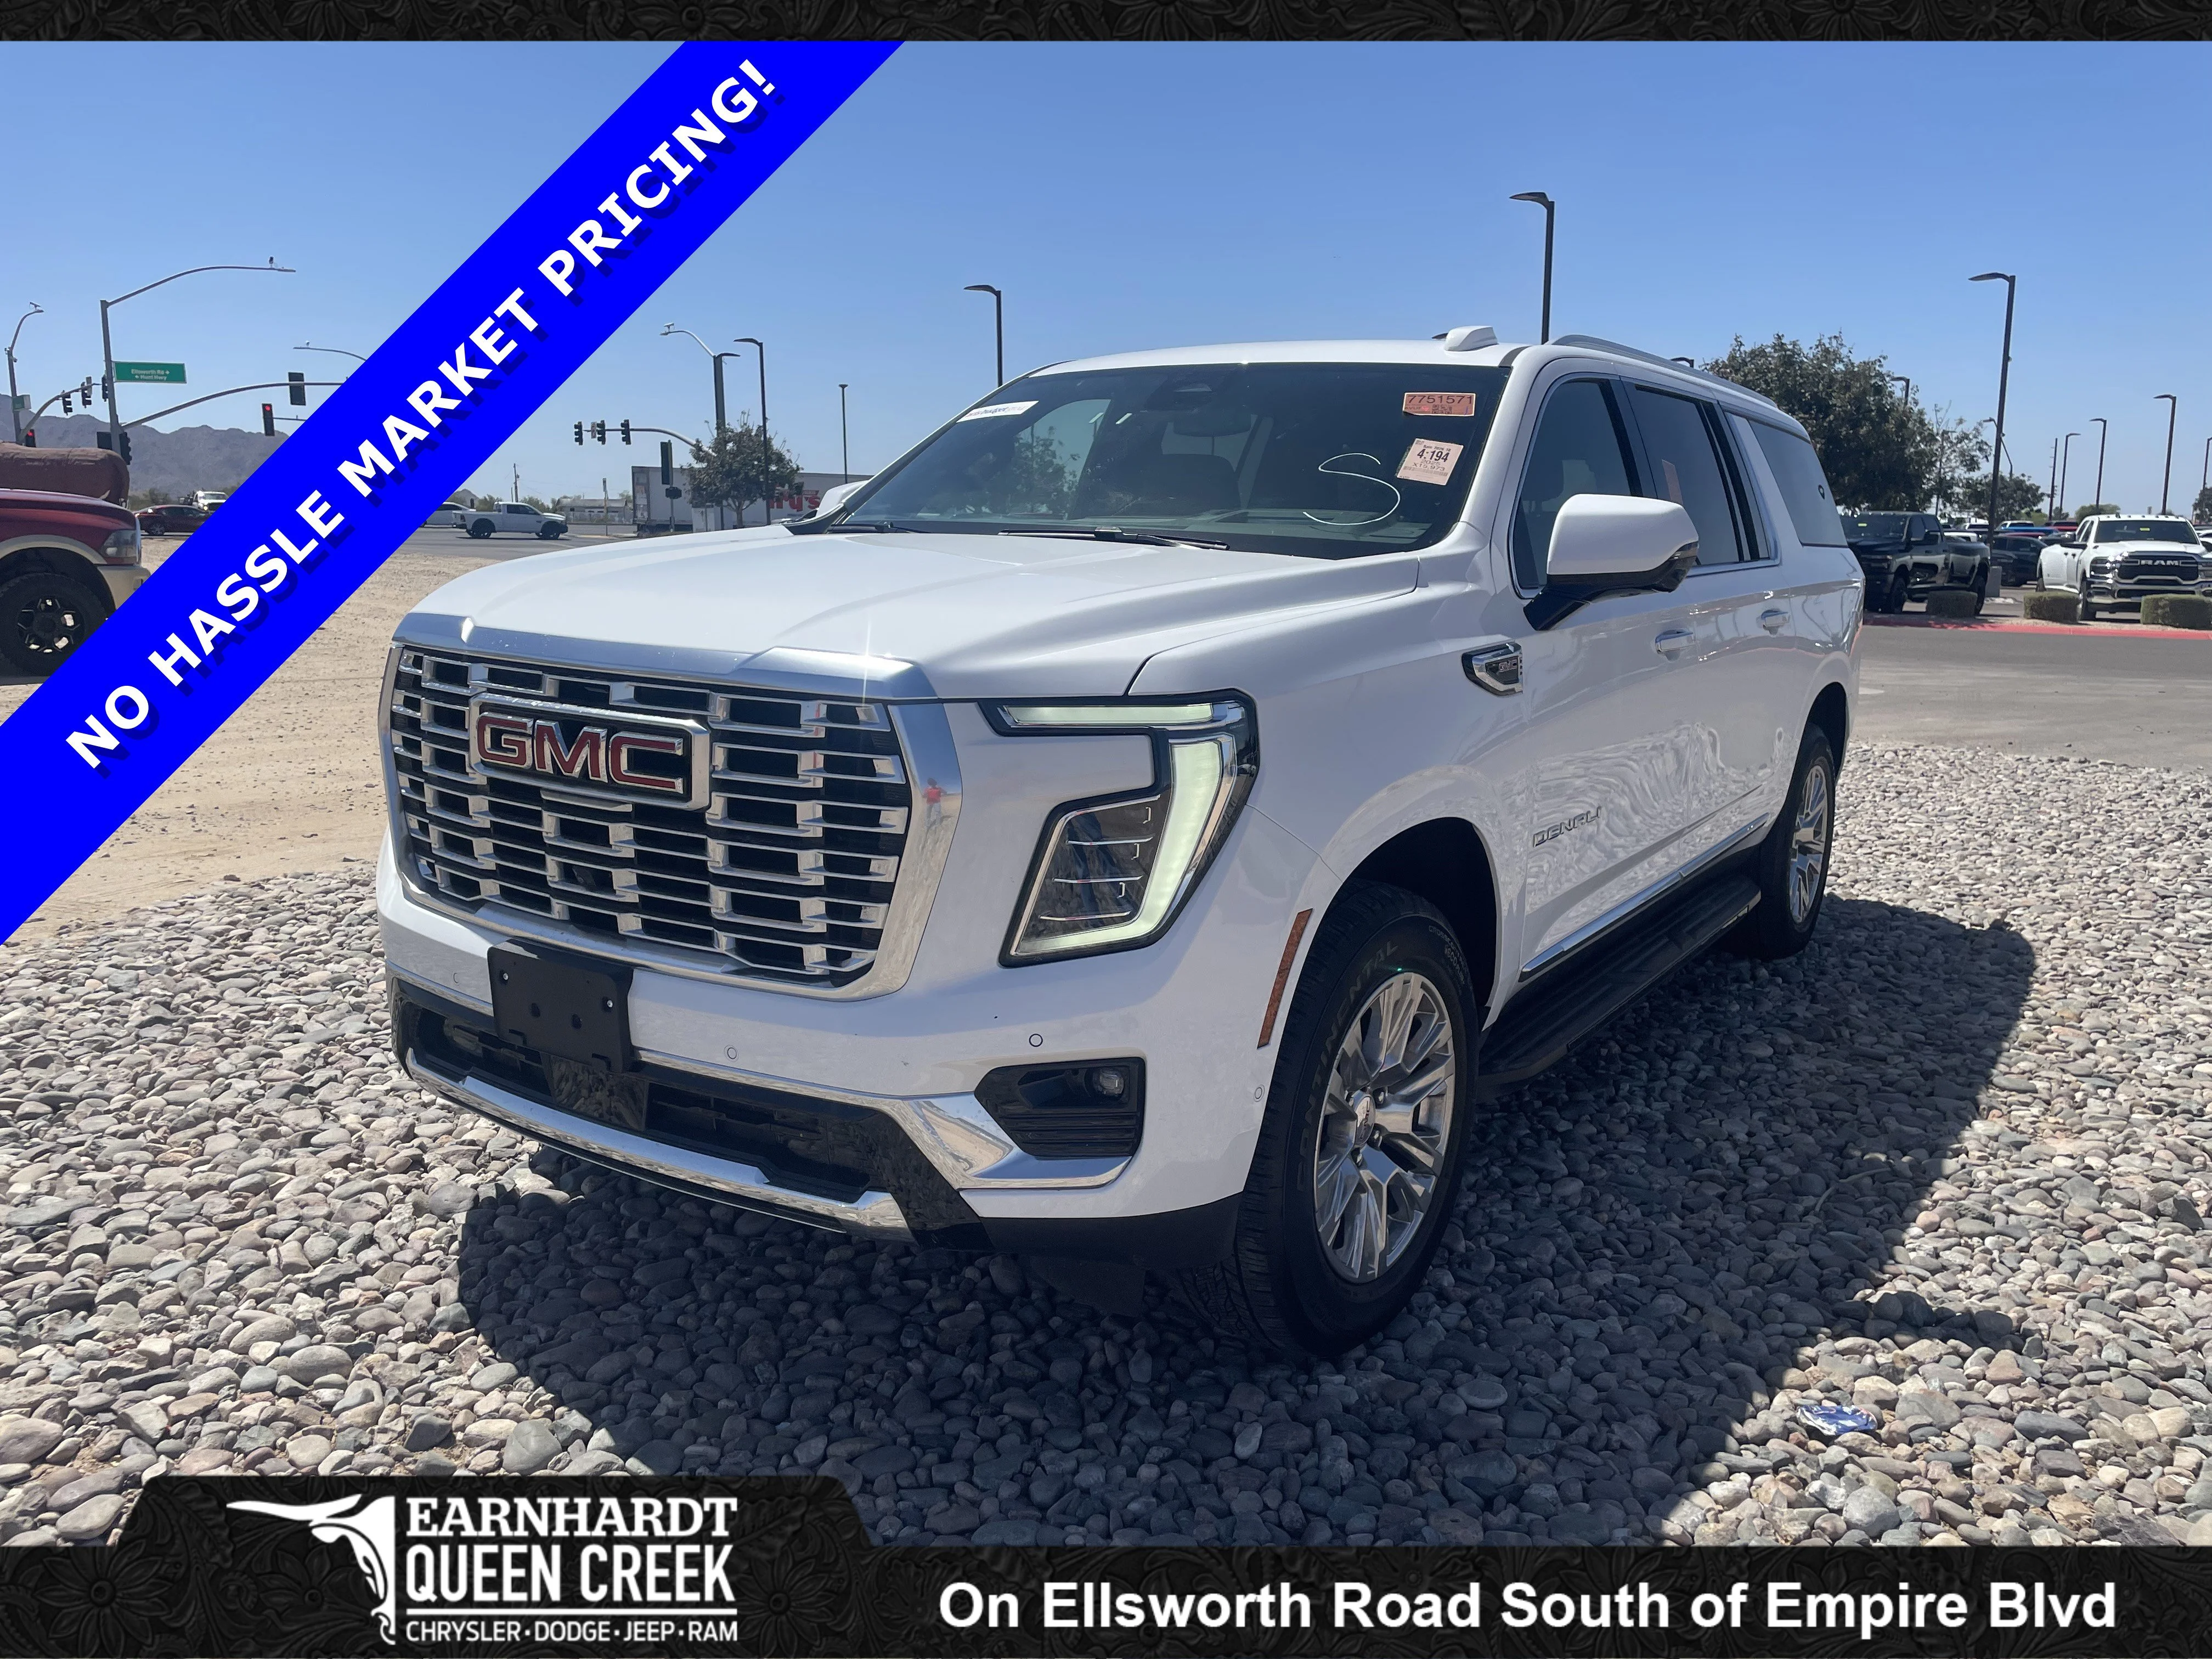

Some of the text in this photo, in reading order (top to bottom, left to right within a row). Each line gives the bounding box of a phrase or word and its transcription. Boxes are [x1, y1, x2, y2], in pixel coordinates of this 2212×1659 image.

[1408, 395, 1472, 404] 7751571
[1498, 659, 1517, 673] GMC
[476, 712, 684, 794] GMC
[1533, 805, 1601, 848] DENALI
